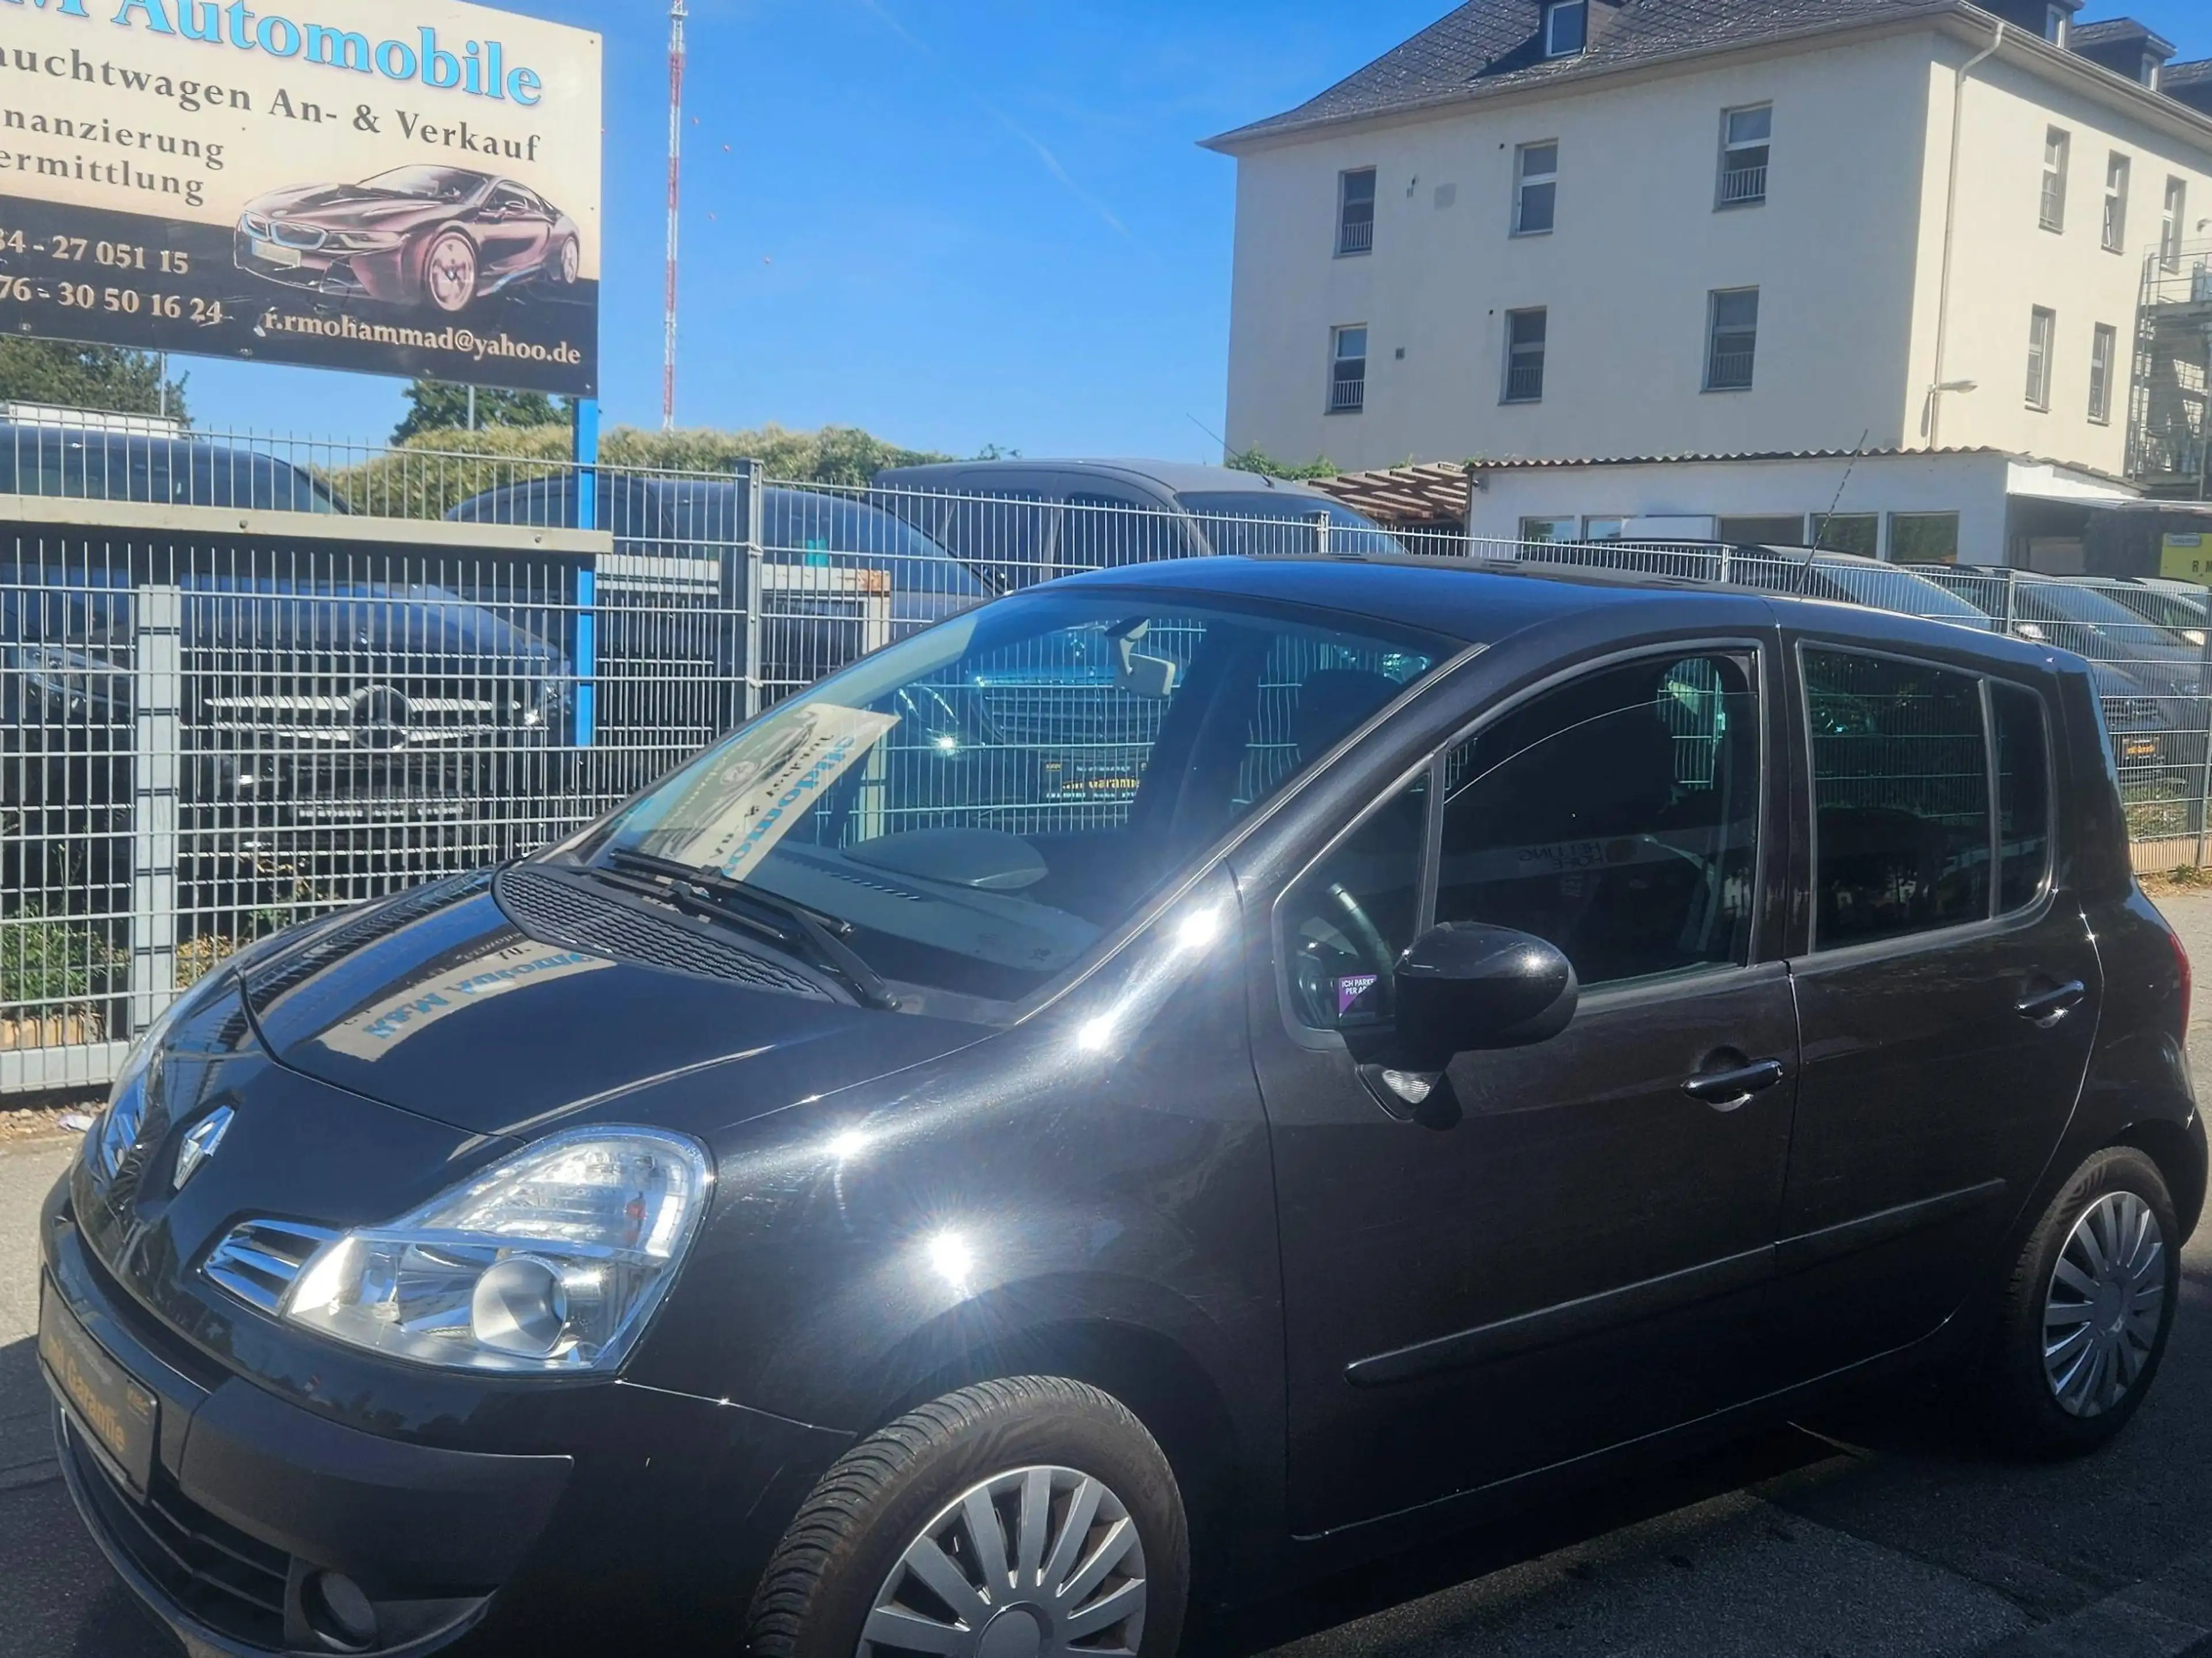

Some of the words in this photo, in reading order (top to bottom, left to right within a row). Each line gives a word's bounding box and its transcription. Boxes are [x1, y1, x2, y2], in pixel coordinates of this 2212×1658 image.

[3, 109, 224, 170] nanzierung
[268, 88, 337, 123] An-
[353, 104, 381, 133] &
[395, 109, 541, 161] Verkauf
[52, 235, 88, 261] 27
[95, 241, 146, 268] 051
[159, 249, 189, 274] 15
[58, 282, 95, 309] 30
[104, 288, 139, 313] 50
[151, 294, 181, 318] 16
[189, 297, 223, 324] 24
